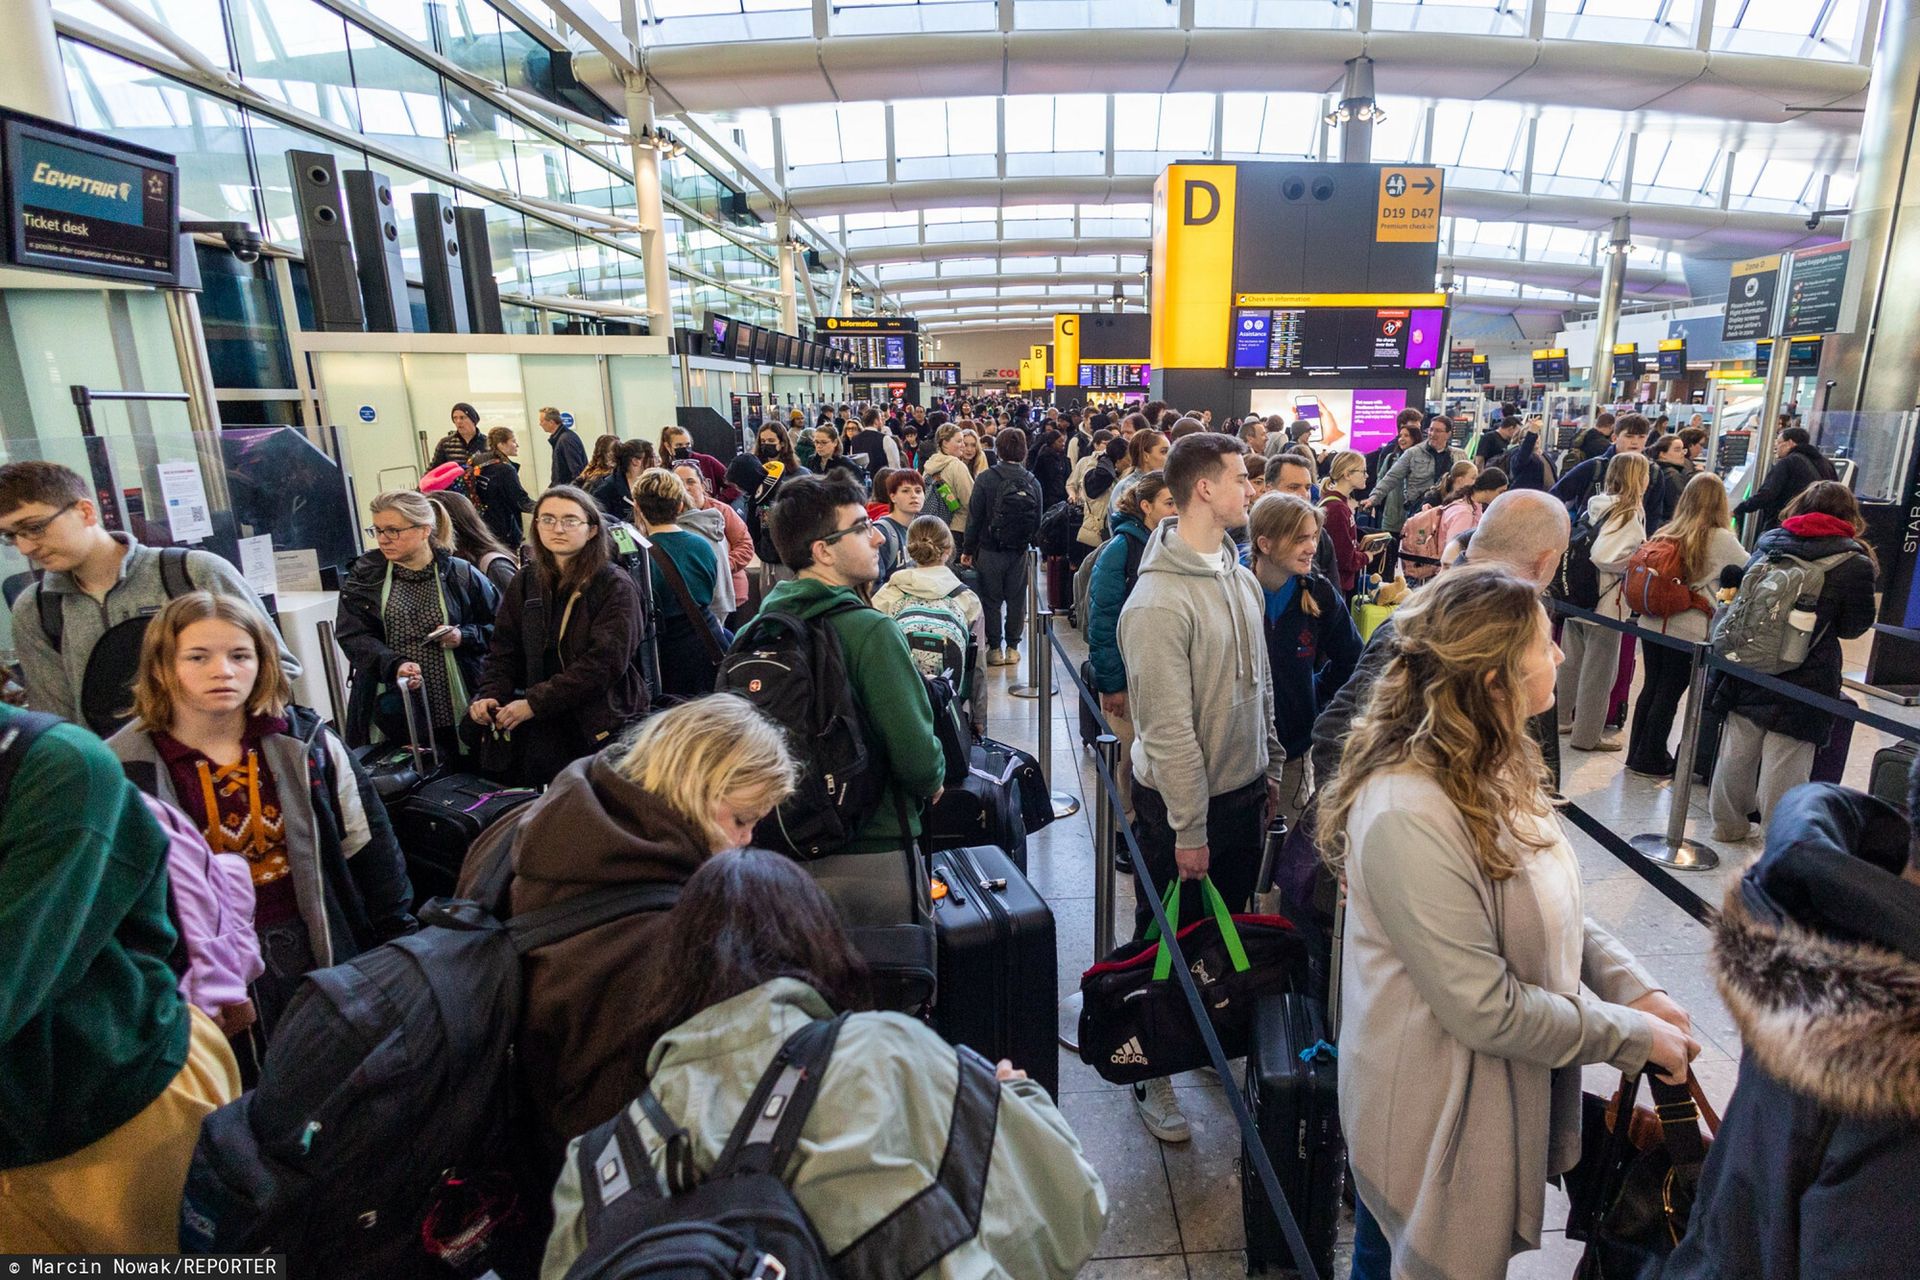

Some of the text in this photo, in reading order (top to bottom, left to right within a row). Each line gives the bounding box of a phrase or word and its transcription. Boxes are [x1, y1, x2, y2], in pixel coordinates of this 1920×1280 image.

[33, 162, 118, 199] EGYPTAIR
[1184, 180, 1221, 225] D
[1383, 208, 1434, 219] D19 D47
[23, 213, 89, 236] Ticket desk
[1062, 320, 1074, 336] C
[1035, 349, 1042, 359] B
[1111, 1052, 1148, 1066] adidas
